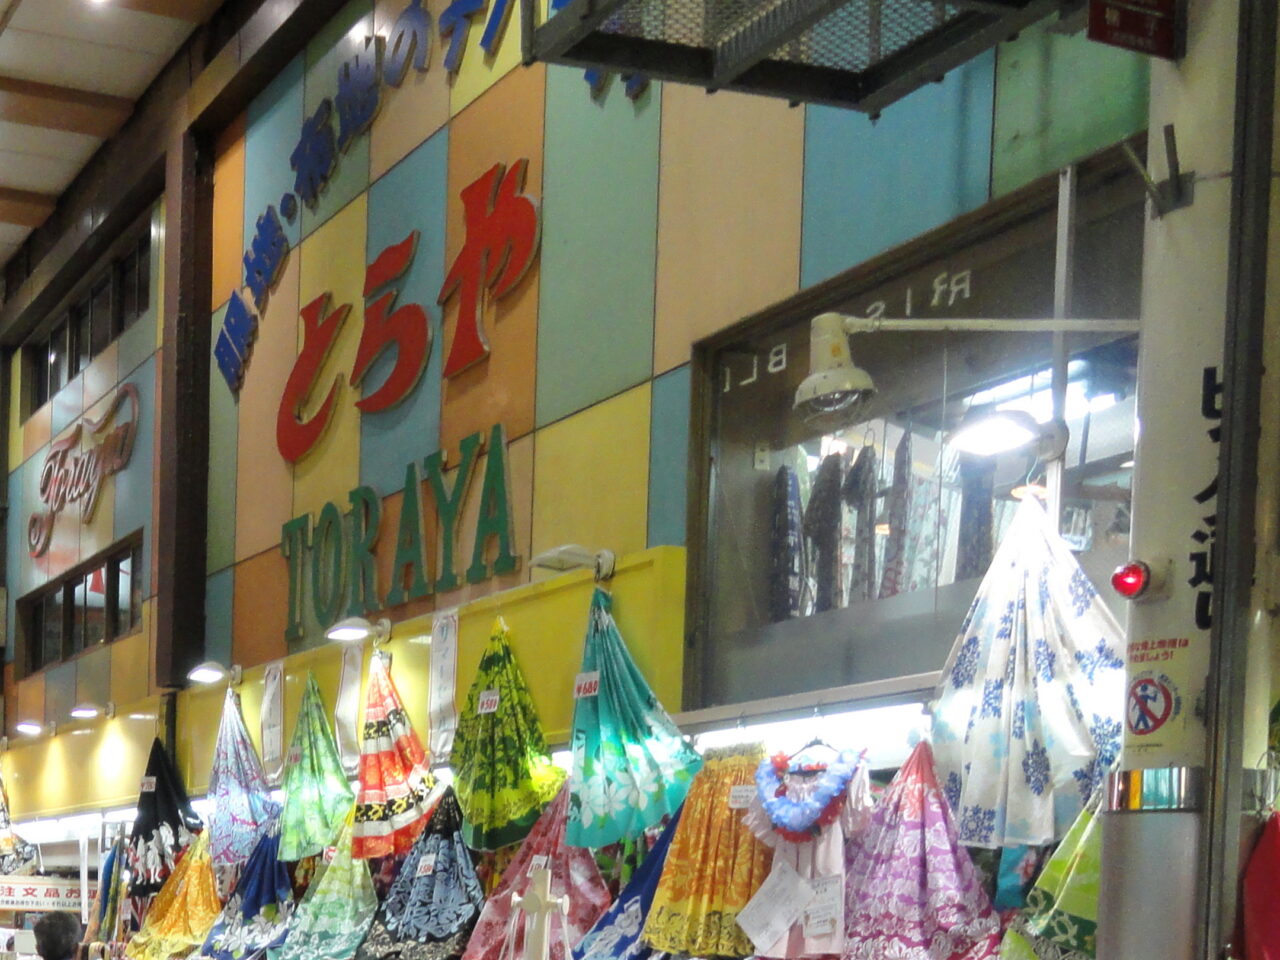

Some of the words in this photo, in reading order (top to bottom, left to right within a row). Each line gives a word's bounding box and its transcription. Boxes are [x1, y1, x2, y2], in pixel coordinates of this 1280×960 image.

[274, 157, 542, 464] とらや
[281, 423, 520, 646] TORAYA
